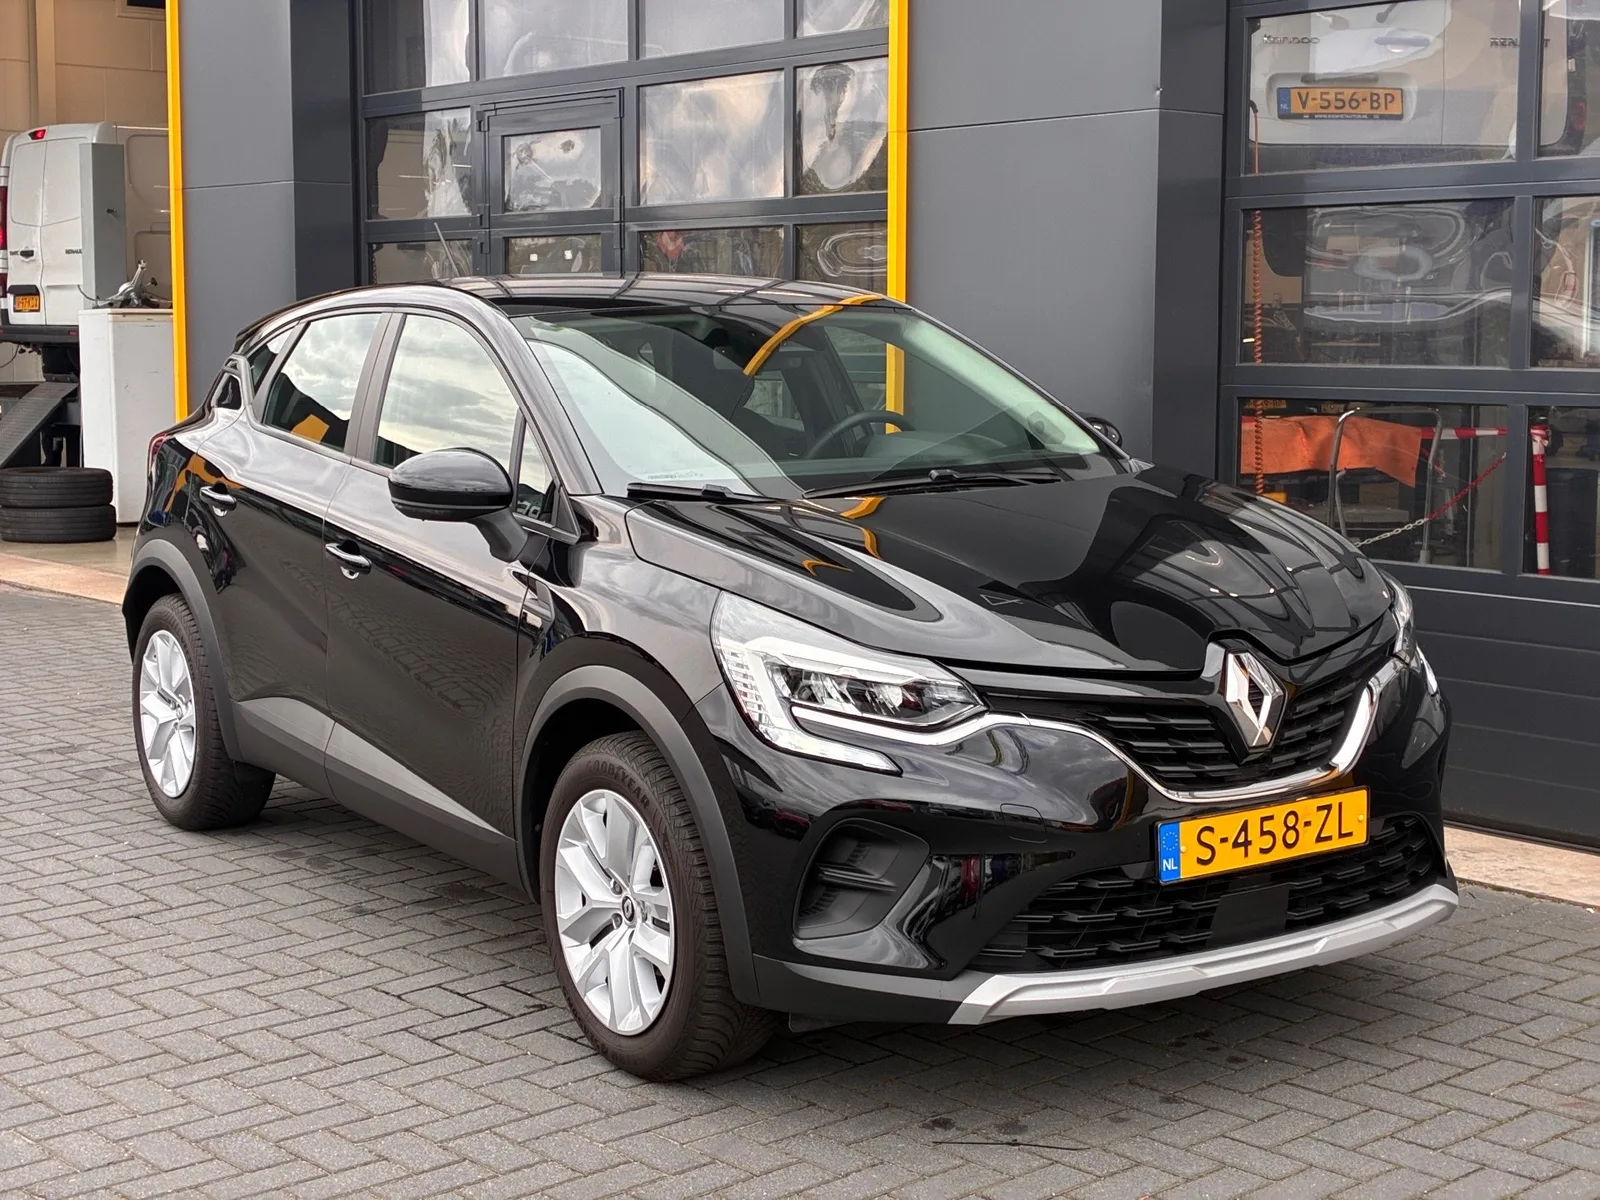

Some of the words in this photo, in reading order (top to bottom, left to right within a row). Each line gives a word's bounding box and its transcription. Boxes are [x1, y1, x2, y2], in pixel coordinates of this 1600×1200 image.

[1297, 92, 1395, 110] V-556-BP
[586, 759, 650, 808] GOODYEAR
[1196, 801, 1353, 866] S-458-ZL
[1163, 858, 1178, 871] NL
